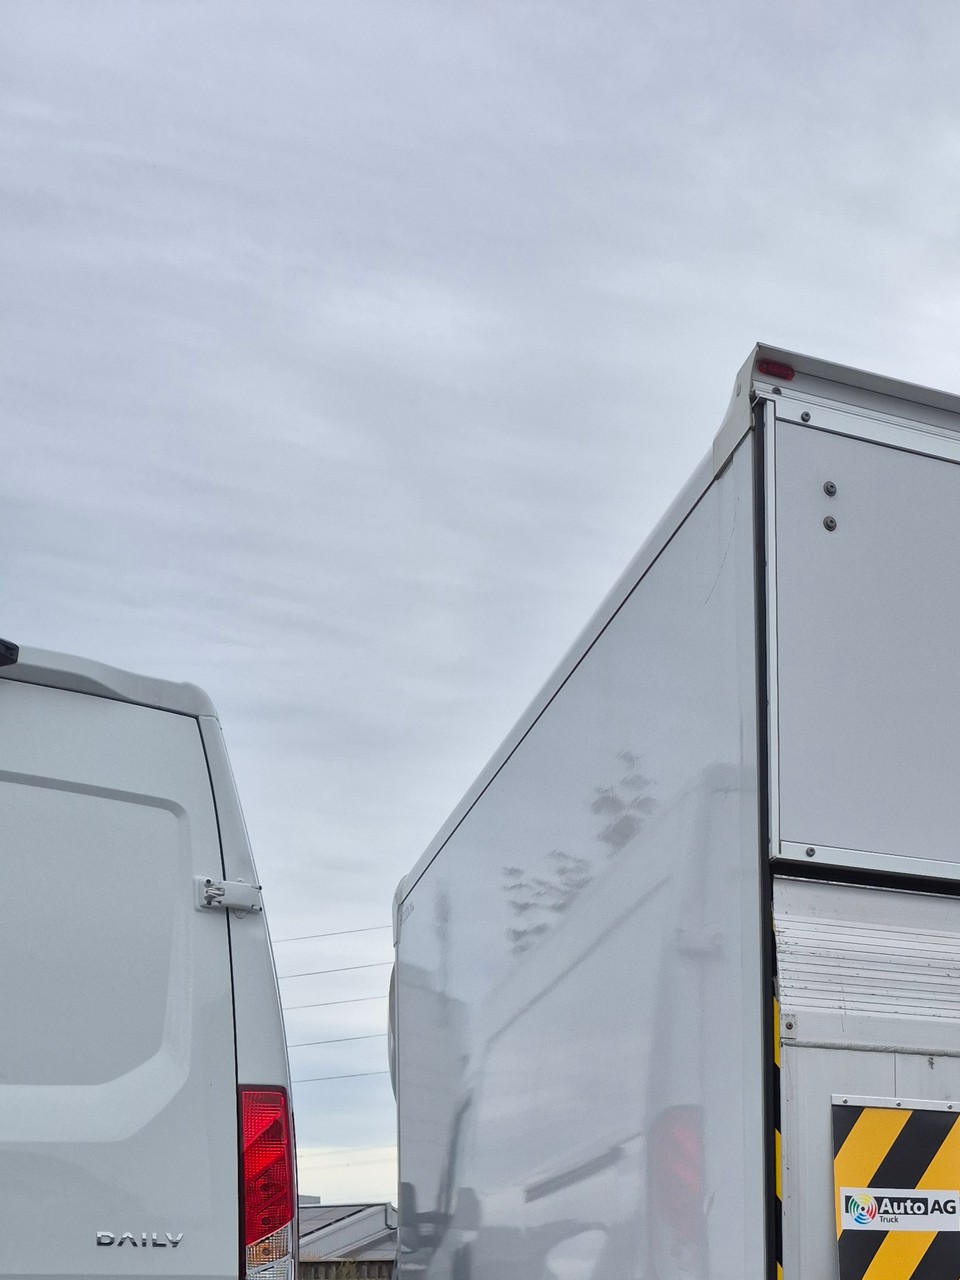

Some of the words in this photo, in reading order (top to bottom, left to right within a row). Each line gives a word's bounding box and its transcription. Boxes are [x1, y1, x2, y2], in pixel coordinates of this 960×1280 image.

[879, 1198, 925, 1215] Auto
[930, 1199, 956, 1215] AG
[879, 1215, 899, 1223] Truck
[96, 1231, 184, 1247] DAILY
